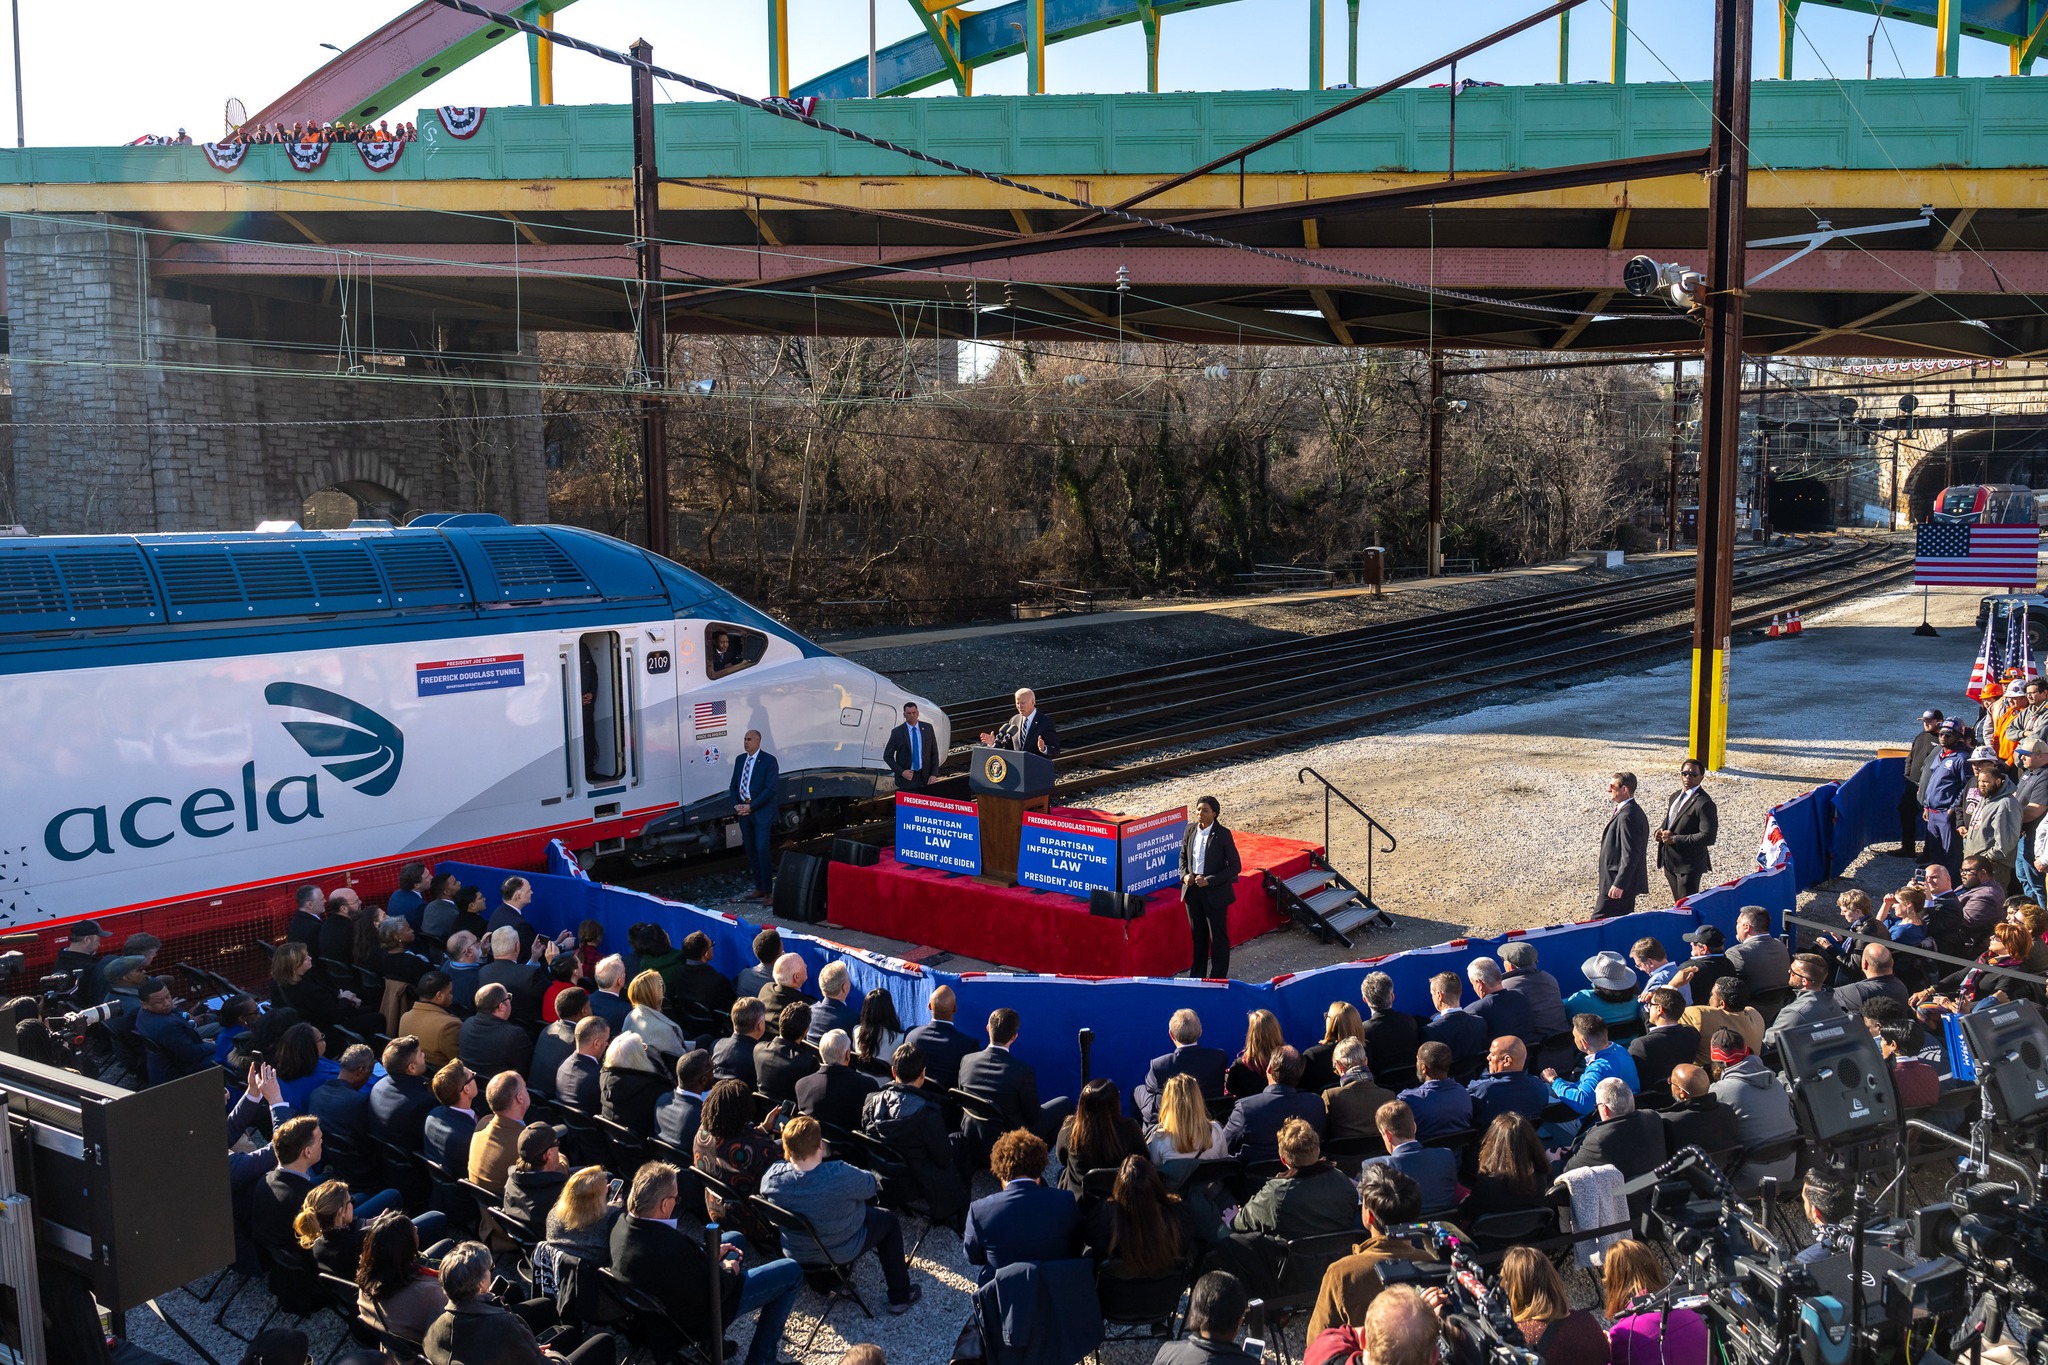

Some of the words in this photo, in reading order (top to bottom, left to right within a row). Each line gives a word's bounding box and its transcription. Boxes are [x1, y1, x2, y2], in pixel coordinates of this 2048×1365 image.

[648, 656, 668, 669] 2109
[420, 673, 458, 684] FREDERICK
[459, 670, 495, 681] DOUGLASS
[495, 667, 521, 676] TUNNEL
[44, 760, 324, 862] acela
[904, 796, 929, 806] FREDERICK
[930, 800, 954, 810] DOUGLASS
[955, 804, 974, 813] TUNNEL
[914, 816, 962, 829] BIPARTISAN
[1027, 816, 1057, 826] FREDERICK
[1057, 821, 1086, 831] DOUGLASS
[1086, 825, 1108, 835] TUNNEL
[1127, 824, 1148, 834] FREDERICK
[1148, 817, 1167, 828] DOUGLASS
[1168, 812, 1182, 821] TUNNEL
[903, 823, 973, 840] INFRASTRUCTURE
[925, 836, 951, 848] LAW
[1040, 836, 1094, 852] BIPARTISAN
[1137, 833, 1174, 851] BIPARTISAN
[901, 848, 938, 862] PRESIDENT
[940, 856, 952, 864] JOE
[954, 858, 975, 869] BIDEN
[1027, 844, 1108, 865] INFRASTRUCTURE
[1127, 840, 1183, 864] INFRASTRUCTURE
[1052, 858, 1081, 873] LAW
[1146, 855, 1166, 870] LAW
[1024, 872, 1066, 887] PRESIDENT
[1068, 880, 1083, 890] JOE
[1127, 876, 1157, 893] PRESIDENT
[1158, 872, 1168, 882] JOE
